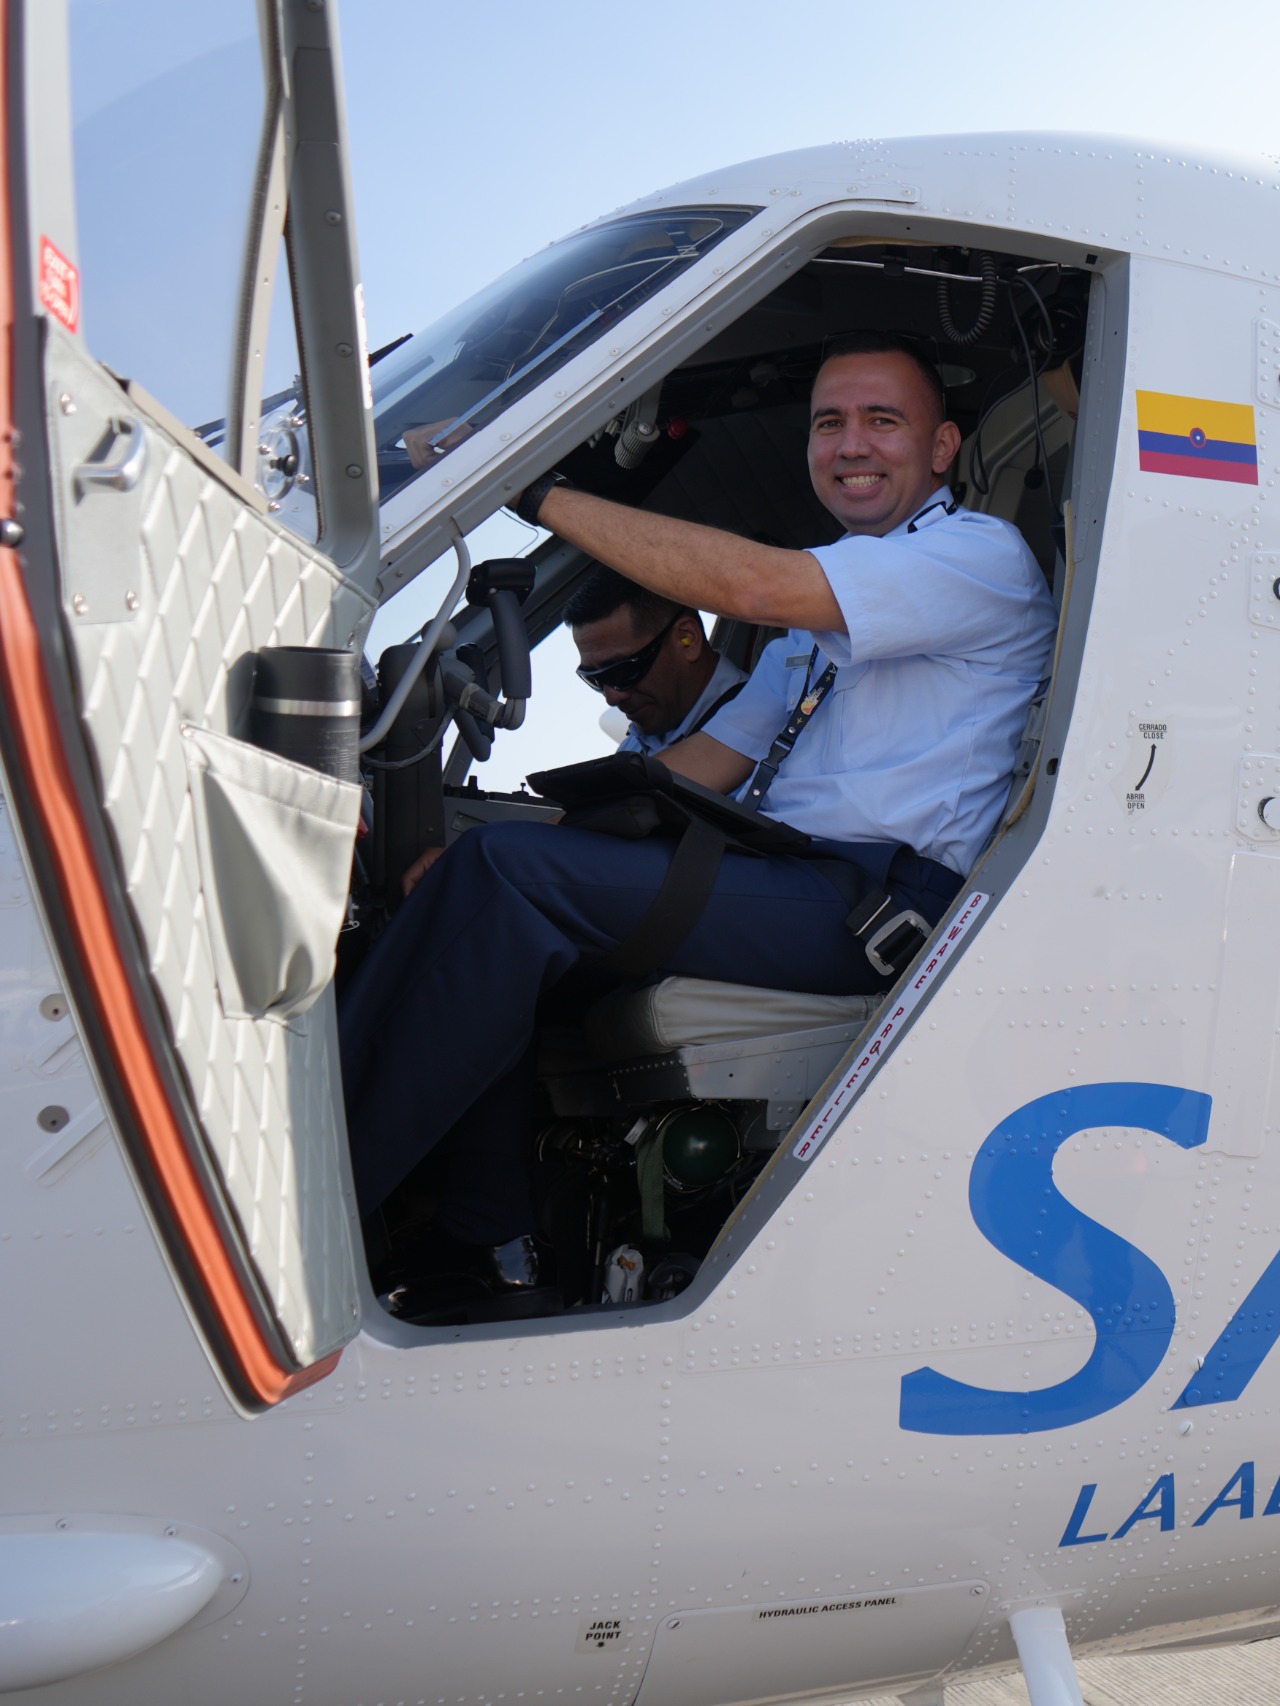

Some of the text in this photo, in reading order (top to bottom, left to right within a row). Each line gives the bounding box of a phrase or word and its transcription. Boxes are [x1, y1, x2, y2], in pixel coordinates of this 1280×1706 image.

[798, 894, 982, 1158] BEWARE PROPELLER
[1058, 1472, 1175, 1547] LA
[758, 1597, 897, 1620] HYDRAULIC ACCESS PANEL
[585, 1631, 622, 1641] POINT
[589, 1620, 622, 1630] JACK
